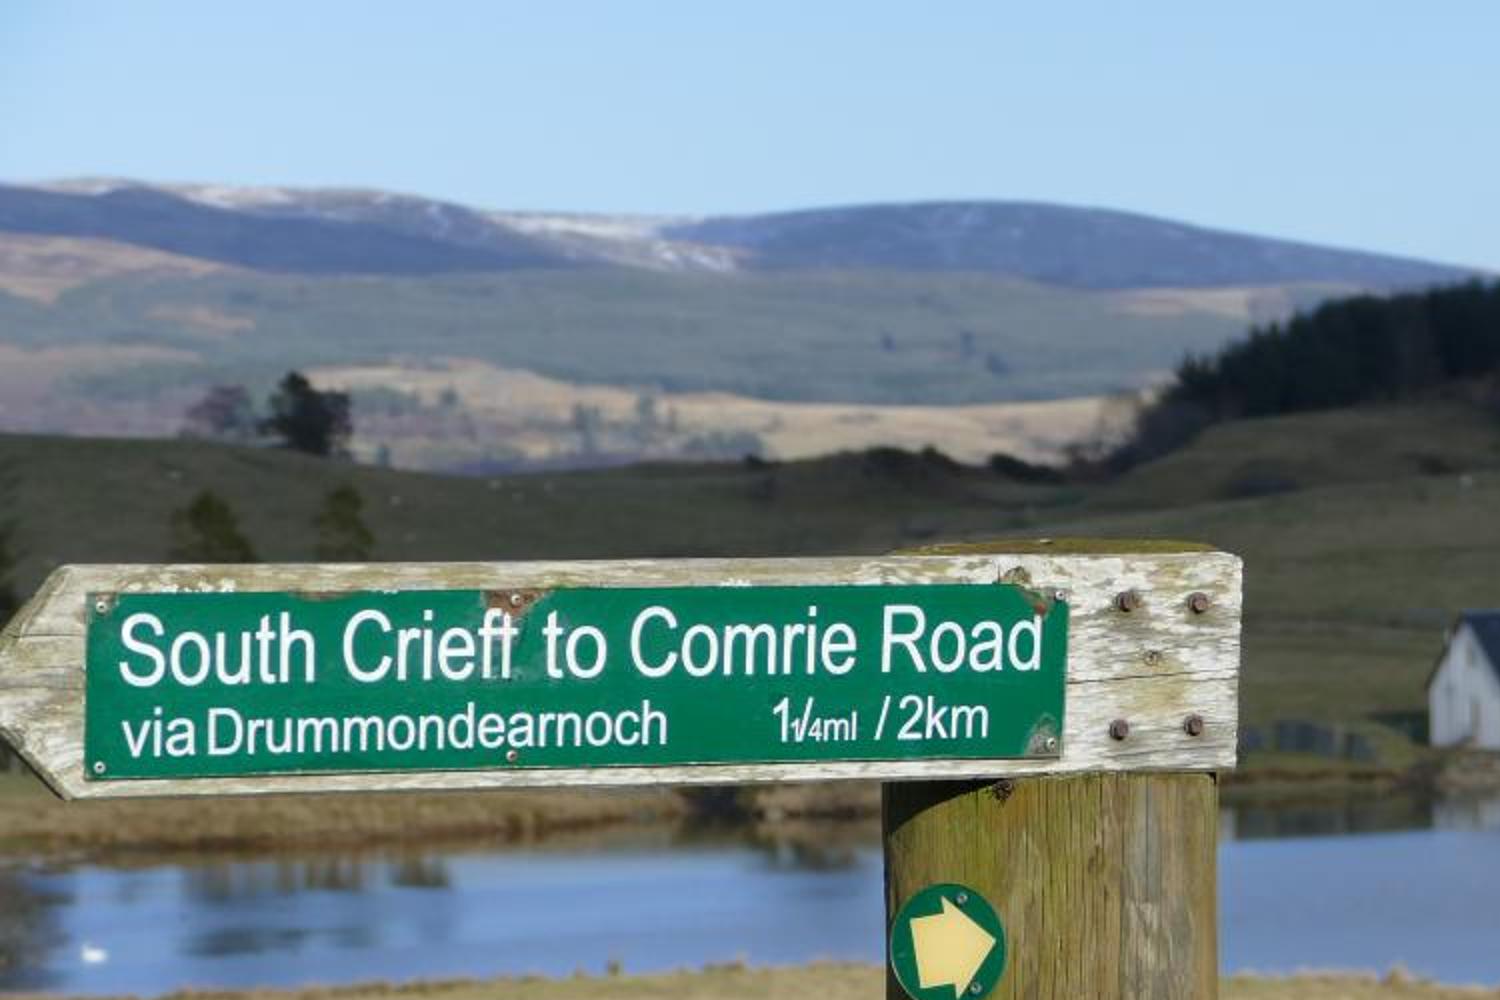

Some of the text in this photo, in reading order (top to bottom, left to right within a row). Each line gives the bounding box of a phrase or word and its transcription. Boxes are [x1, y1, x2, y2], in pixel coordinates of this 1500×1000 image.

[119, 604, 1043, 688] South Crieff to Comrie Road
[121, 699, 668, 758] via Drummondearnoch
